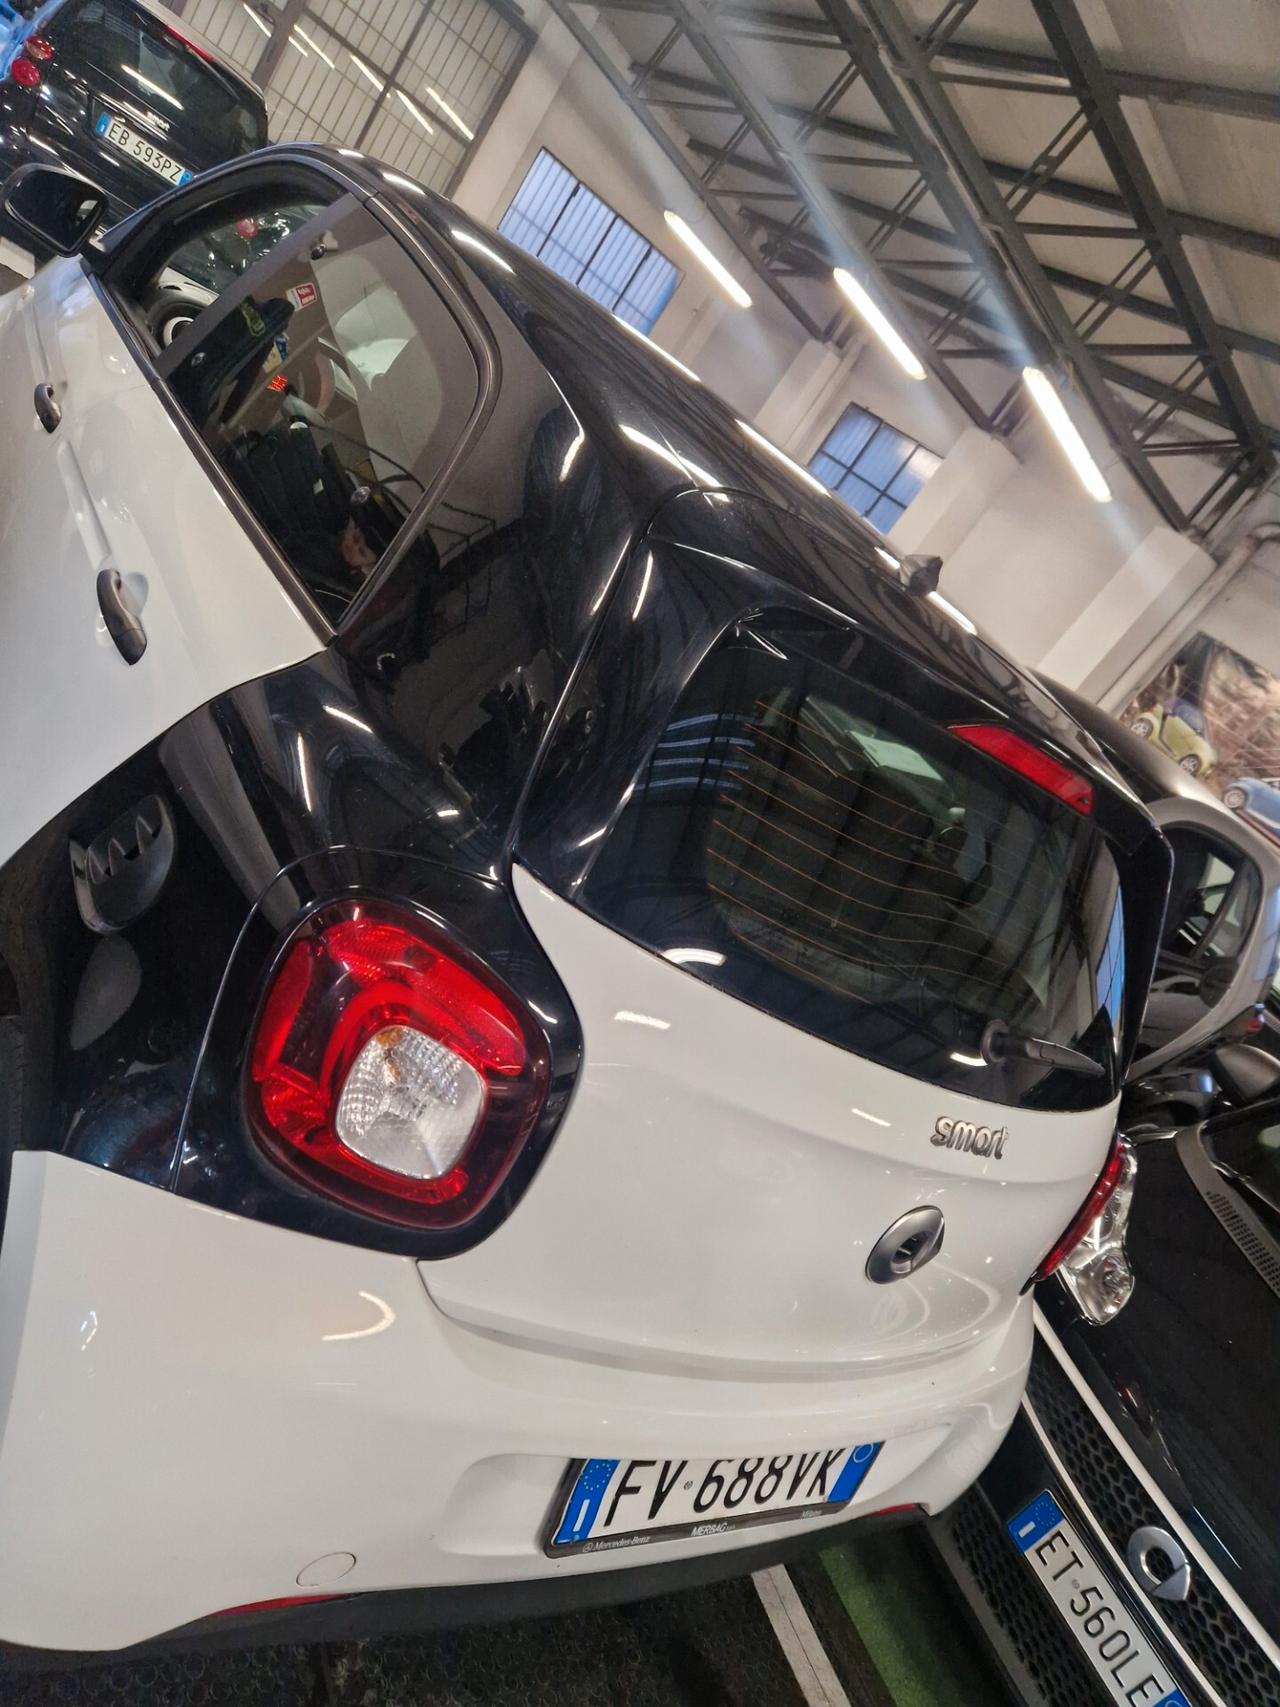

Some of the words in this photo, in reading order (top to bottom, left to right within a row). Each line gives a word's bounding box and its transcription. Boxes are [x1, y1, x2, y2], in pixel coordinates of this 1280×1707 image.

[108, 122, 130, 146] EB
[133, 140, 182, 183] 593PZ
[930, 1116, 1008, 1160] smart
[604, 1459, 688, 1527] FV
[693, 1447, 847, 1513] 688VK
[594, 1535, 651, 1551] Mercedes-Benz
[1035, 1530, 1084, 1581] ET
[1070, 1586, 1165, 1707] 560LE
